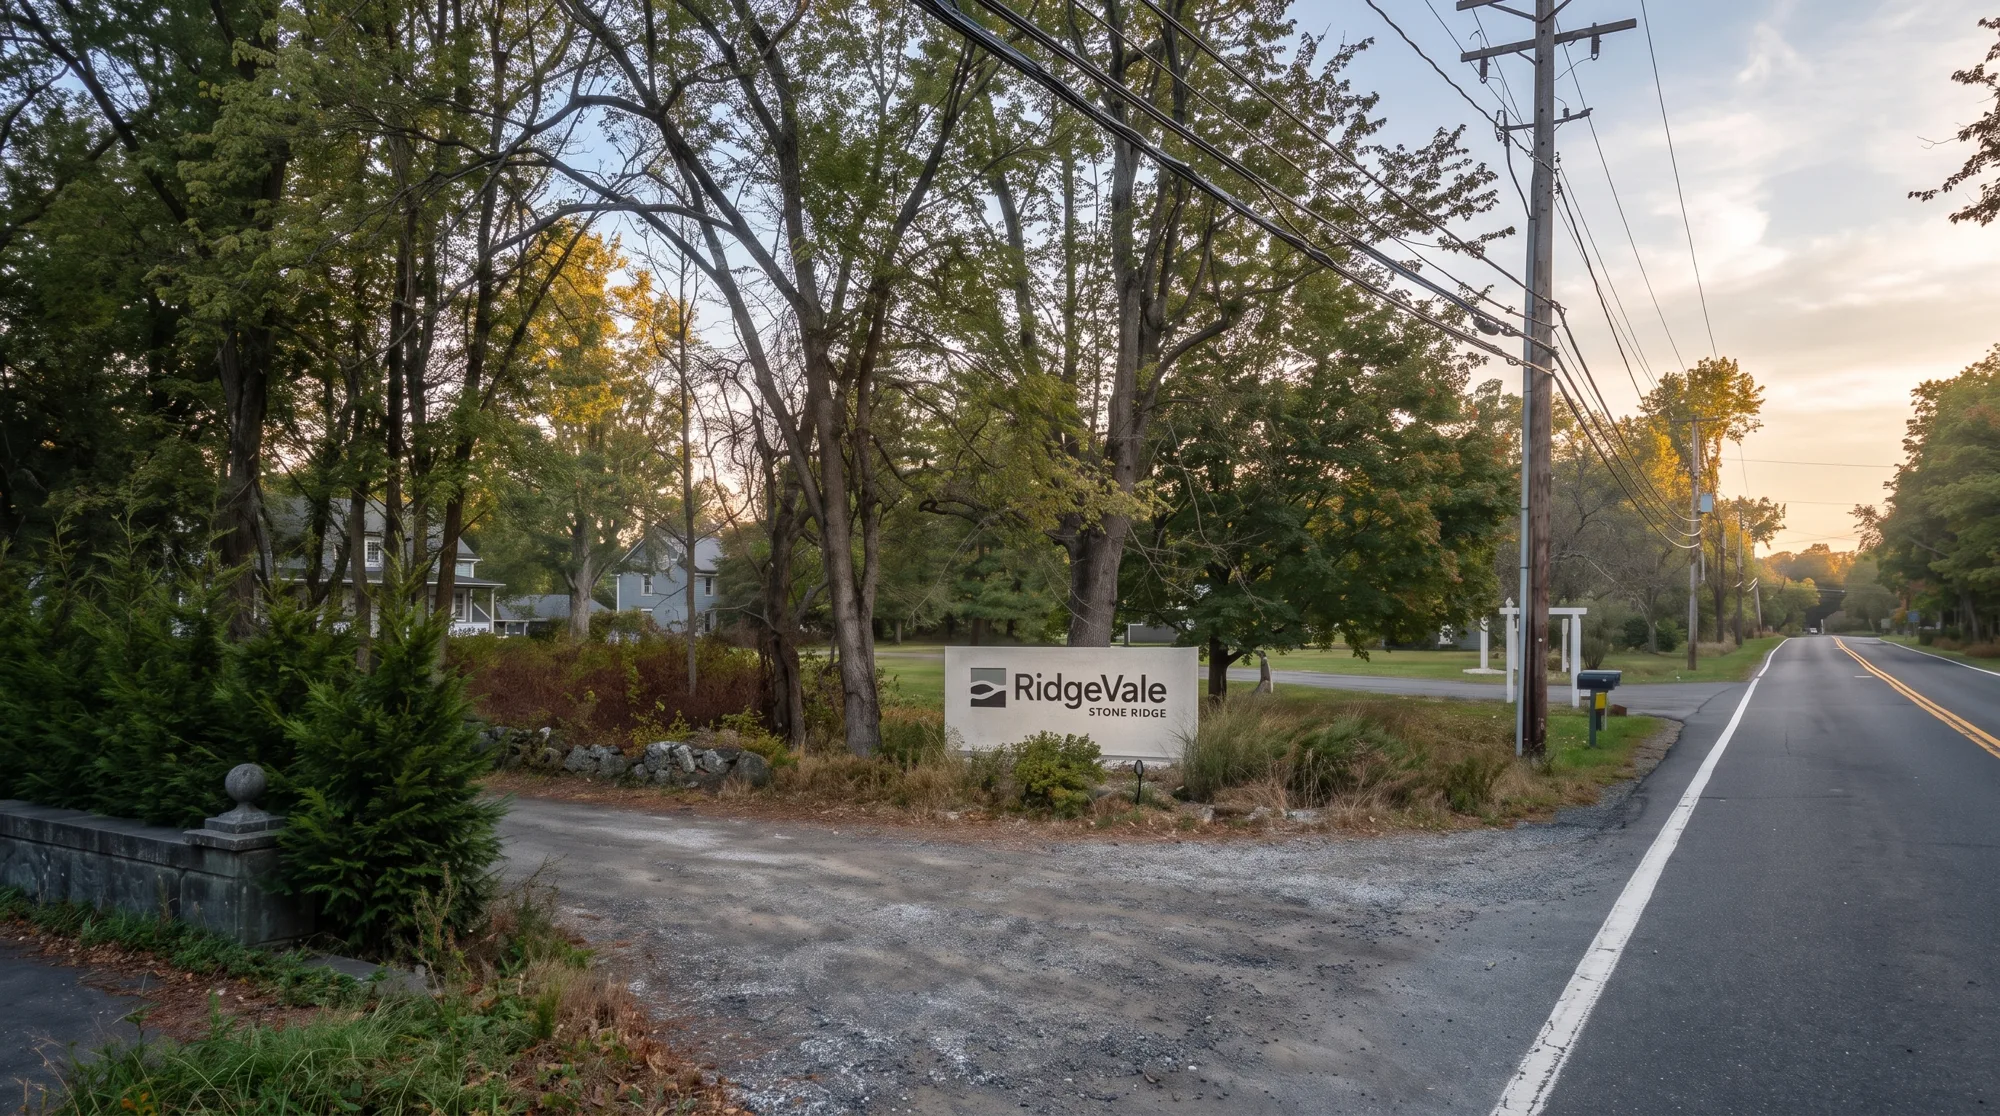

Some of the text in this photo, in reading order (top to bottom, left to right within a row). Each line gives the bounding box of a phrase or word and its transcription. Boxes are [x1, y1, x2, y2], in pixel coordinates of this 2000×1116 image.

[1014, 672, 1167, 710] RidgeVale
[1088, 707, 1167, 718] STONE RIDGE
